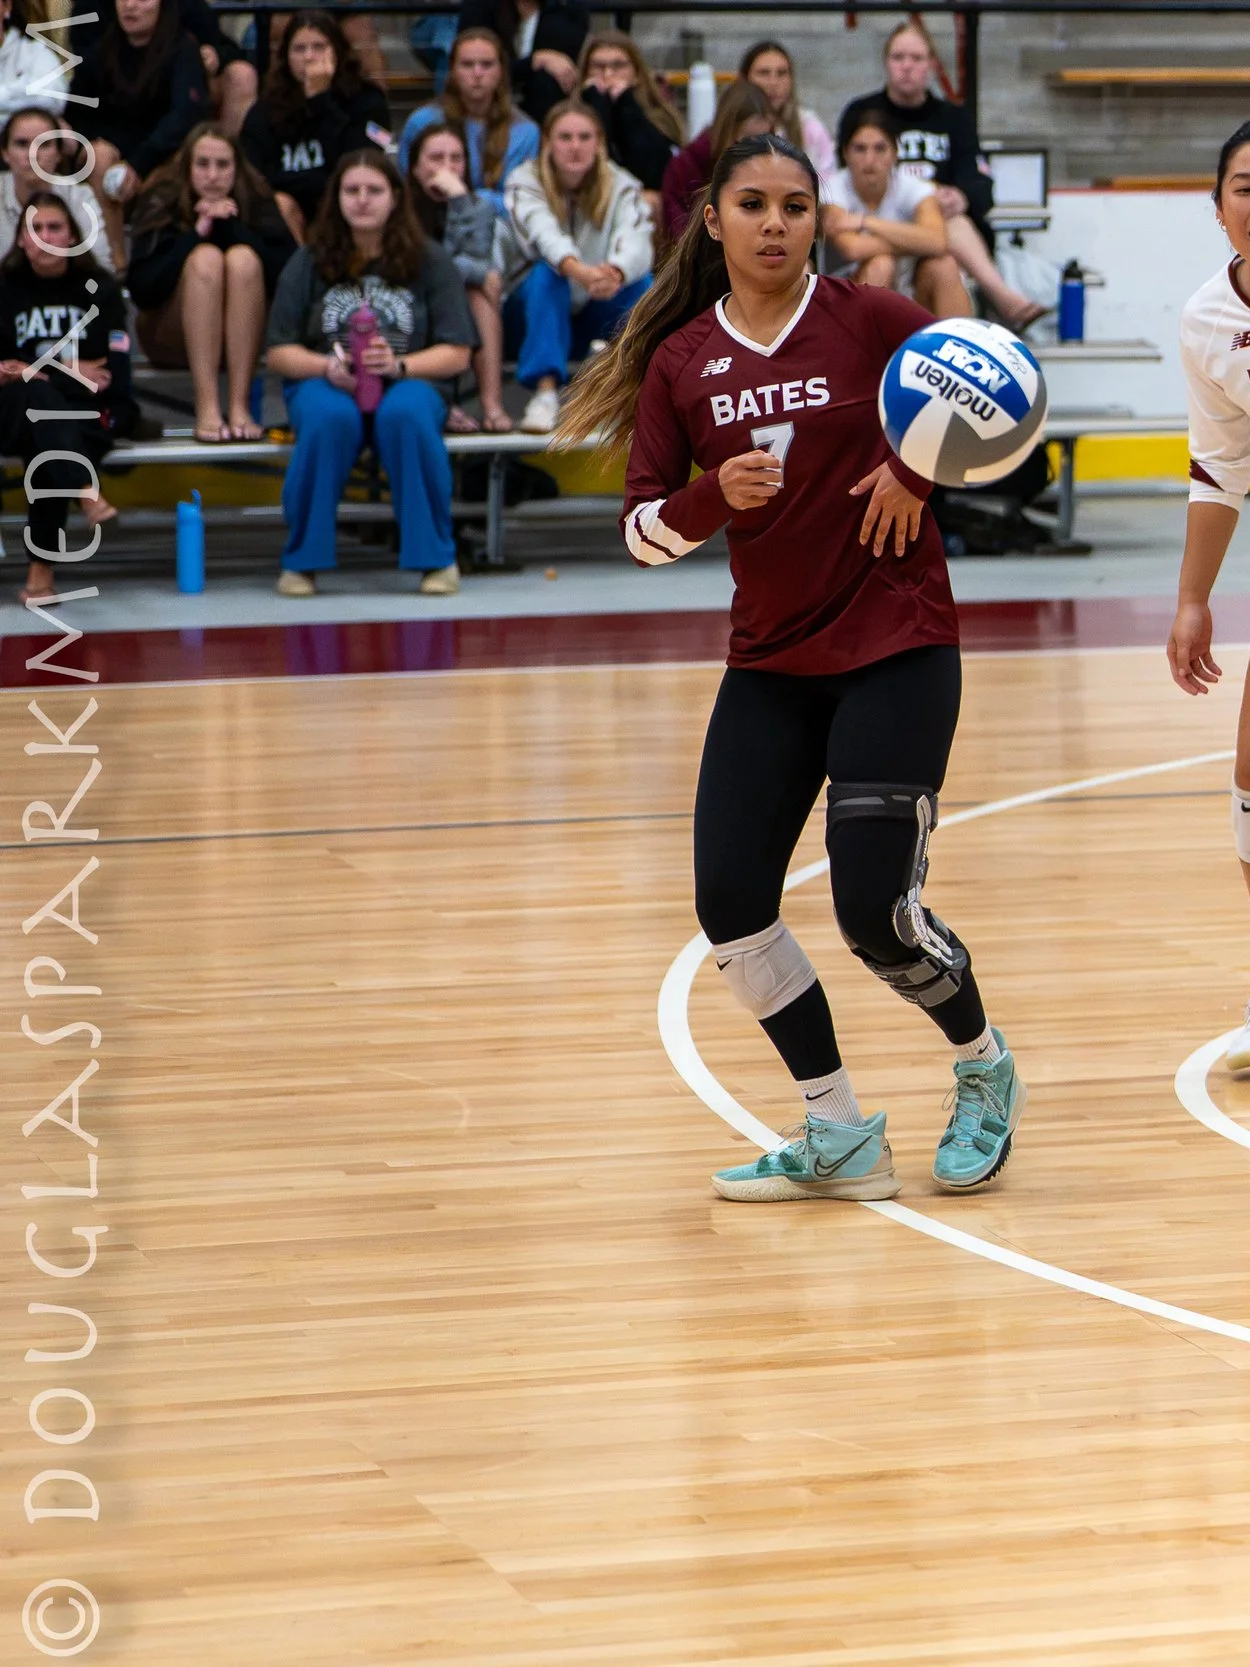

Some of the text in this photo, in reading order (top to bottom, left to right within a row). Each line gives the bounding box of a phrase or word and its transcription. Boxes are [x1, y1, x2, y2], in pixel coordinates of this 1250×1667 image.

[913, 360, 997, 422] molten
[935, 338, 1012, 394] NCAA
[709, 376, 831, 427] BATES
[750, 420, 795, 489] 7
